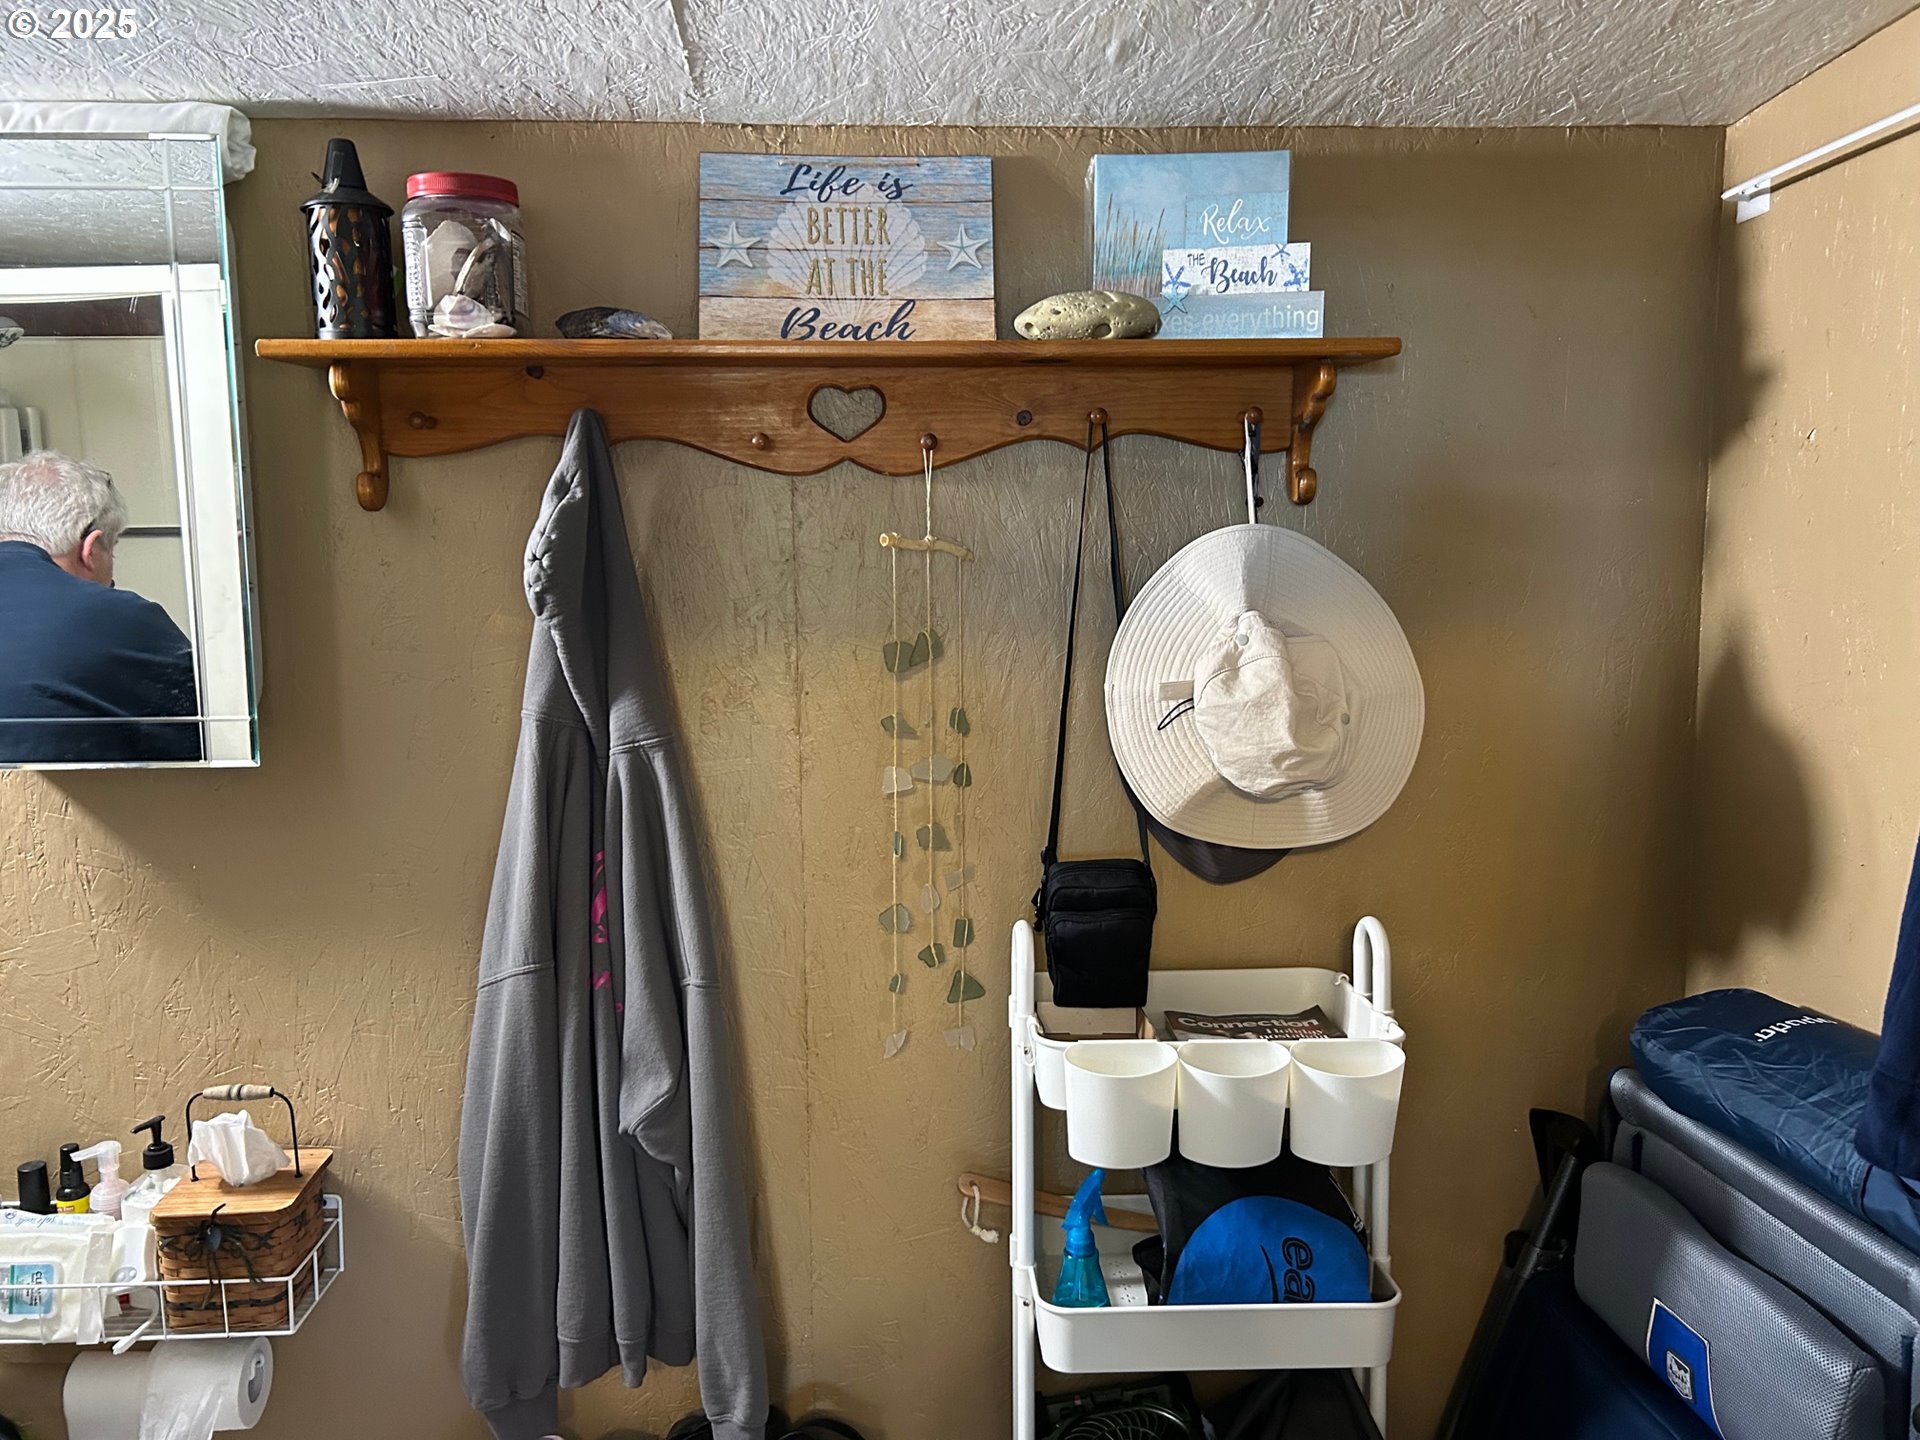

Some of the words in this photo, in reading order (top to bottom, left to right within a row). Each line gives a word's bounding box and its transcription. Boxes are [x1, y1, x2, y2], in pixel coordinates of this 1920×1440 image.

[780, 164, 865, 203] Life
[877, 172, 913, 199] is
[807, 206, 891, 246] BETTER
[1200, 198, 1272, 244] Relax
[805, 257, 835, 296] AT
[848, 257, 889, 296] THE
[1187, 253, 1205, 267] THE
[1202, 256, 1277, 293] Beach
[781, 300, 916, 341] Beach
[1202, 304, 1319, 332] everything
[1178, 1016, 1319, 1029] Connection
